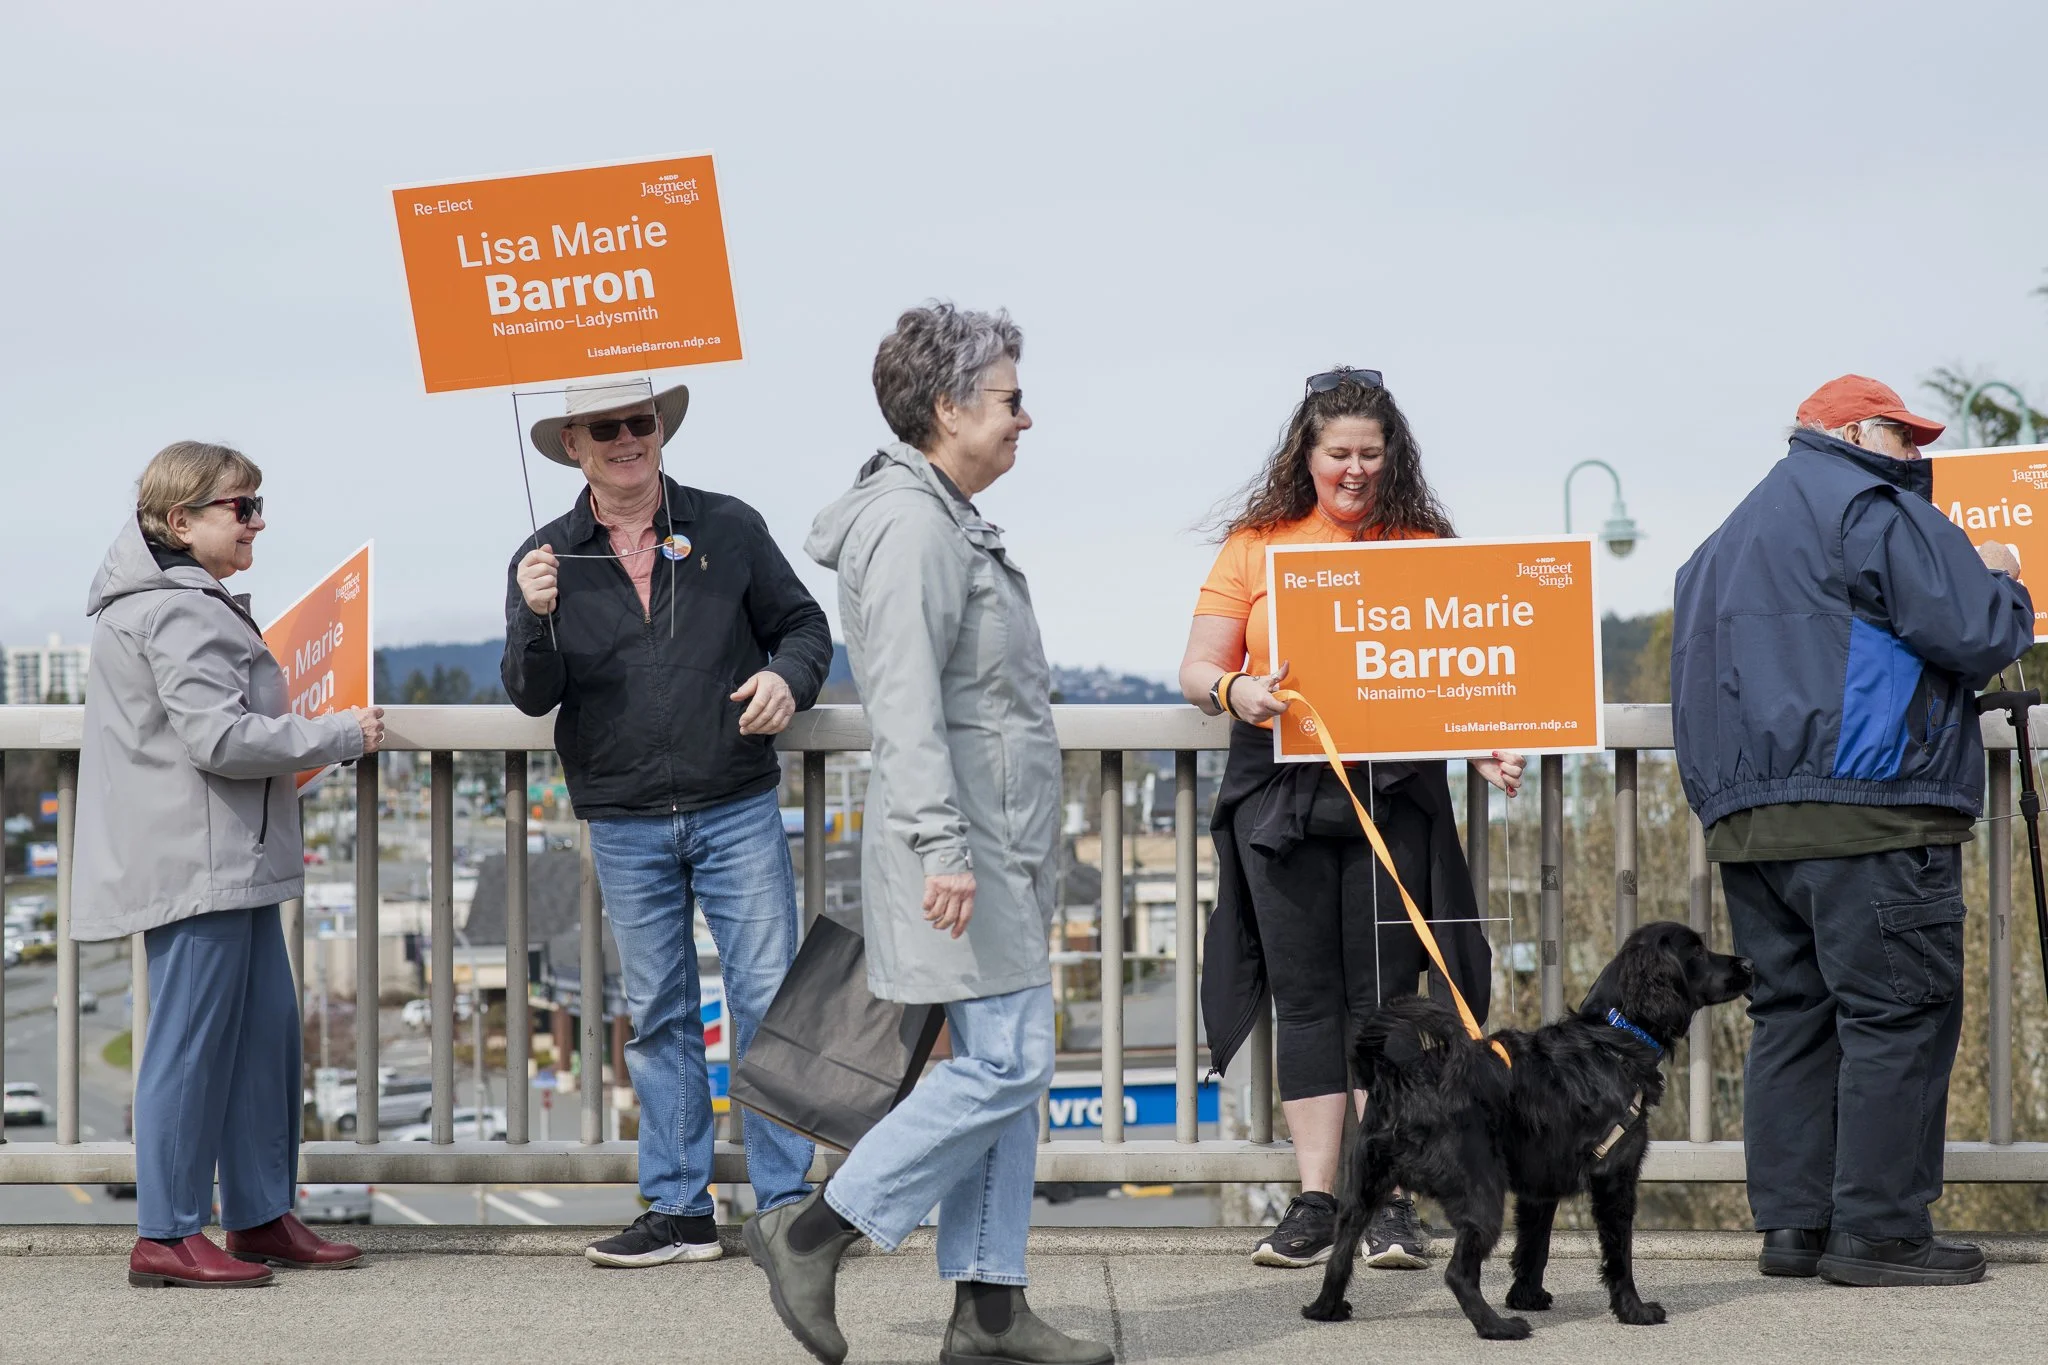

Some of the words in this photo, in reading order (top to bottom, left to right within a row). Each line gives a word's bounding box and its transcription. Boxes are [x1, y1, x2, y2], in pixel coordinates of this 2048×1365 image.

[640, 177, 698, 198] Jagmeet
[663, 189, 700, 206] Singh
[413, 198, 474, 216] Re-Elect
[456, 231, 541, 269] Lisa
[551, 214, 668, 258] Marie
[484, 267, 656, 316] Barron
[586, 336, 721, 359] LisaMarieBarron.ndp.ca
[1283, 569, 1361, 590] Re-Elect
[1515, 562, 1573, 579] Jagmeet
[1538, 574, 1573, 589] Singh
[1333, 599, 1412, 633] Lisa
[1424, 593, 1534, 630] Marie
[295, 621, 344, 680] Marie
[1355, 640, 1516, 681] Barron
[291, 669, 335, 720] rron
[1444, 719, 1578, 733] LisaMarieBarron.ndp.ca
[1050, 1095, 1138, 1127] vron
